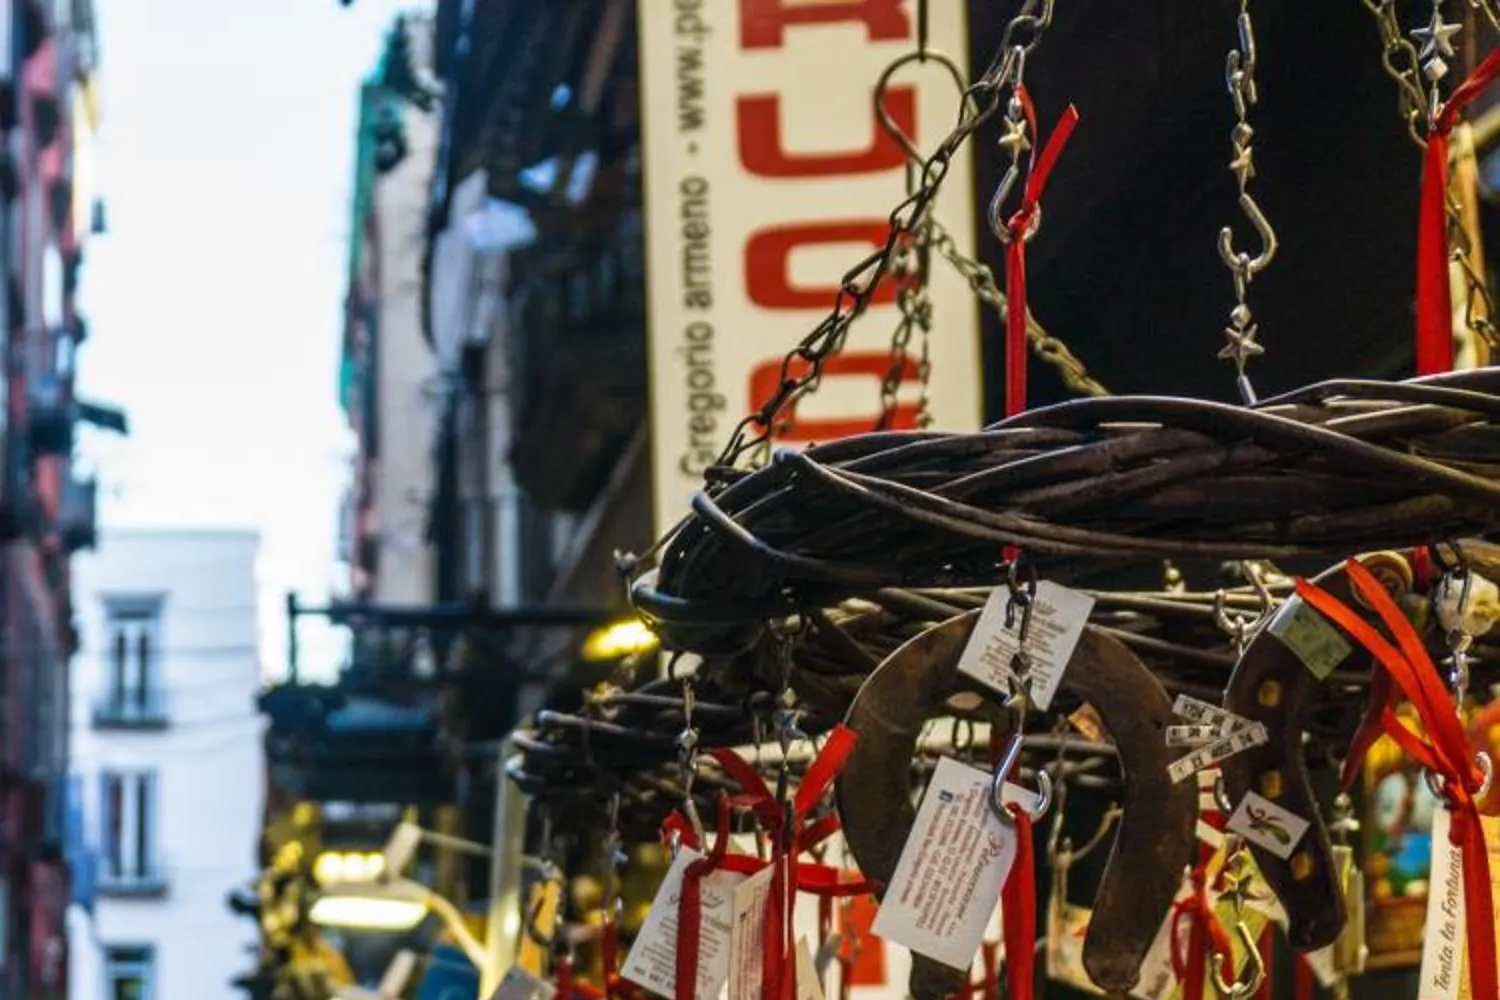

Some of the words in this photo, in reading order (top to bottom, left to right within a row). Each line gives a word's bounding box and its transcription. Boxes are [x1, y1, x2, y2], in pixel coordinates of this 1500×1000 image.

[679, 175, 713, 311] armeno
[1441, 848, 1462, 918] Fortuna
[1439, 922, 1456, 942] la
[1434, 946, 1453, 991] Tenta
